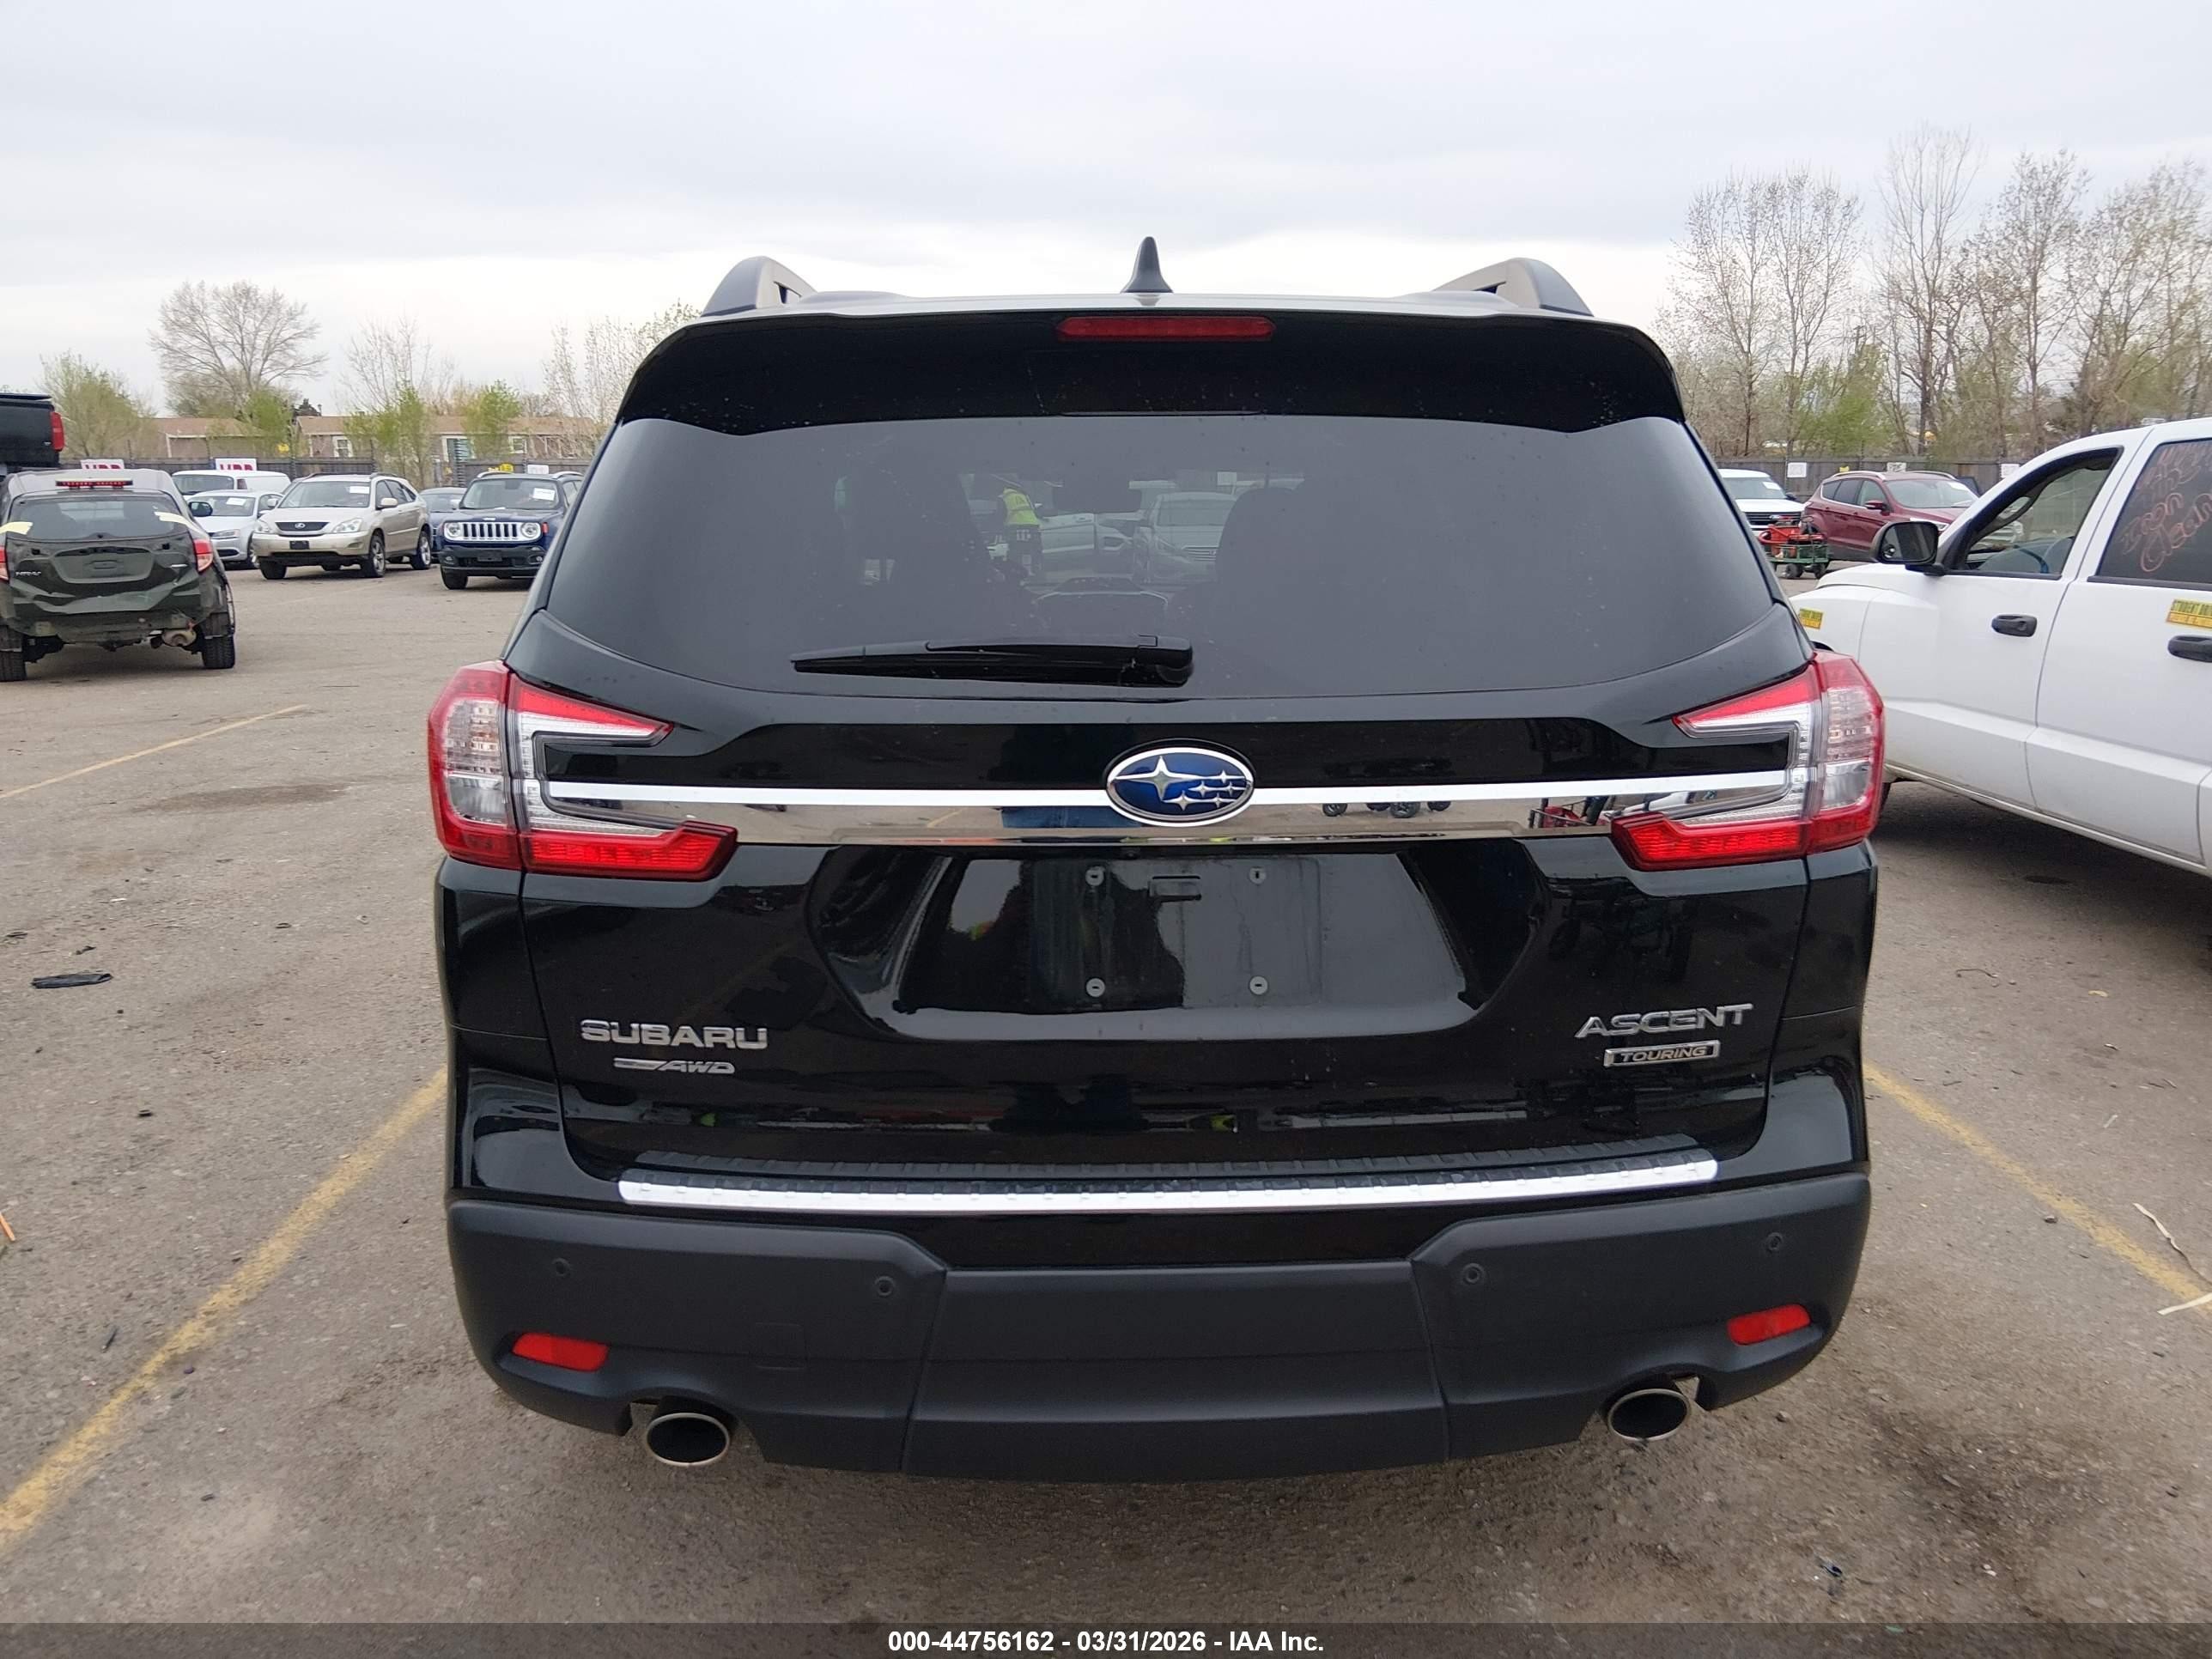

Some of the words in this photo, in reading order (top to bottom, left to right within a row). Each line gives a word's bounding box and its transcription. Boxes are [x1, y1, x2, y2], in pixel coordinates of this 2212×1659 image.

[1574, 1002, 1754, 1038] ASCENT
[580, 1018, 769, 1049] SUBARU
[1620, 1046, 1708, 1063] TOURING
[658, 1060, 735, 1074] AWD
